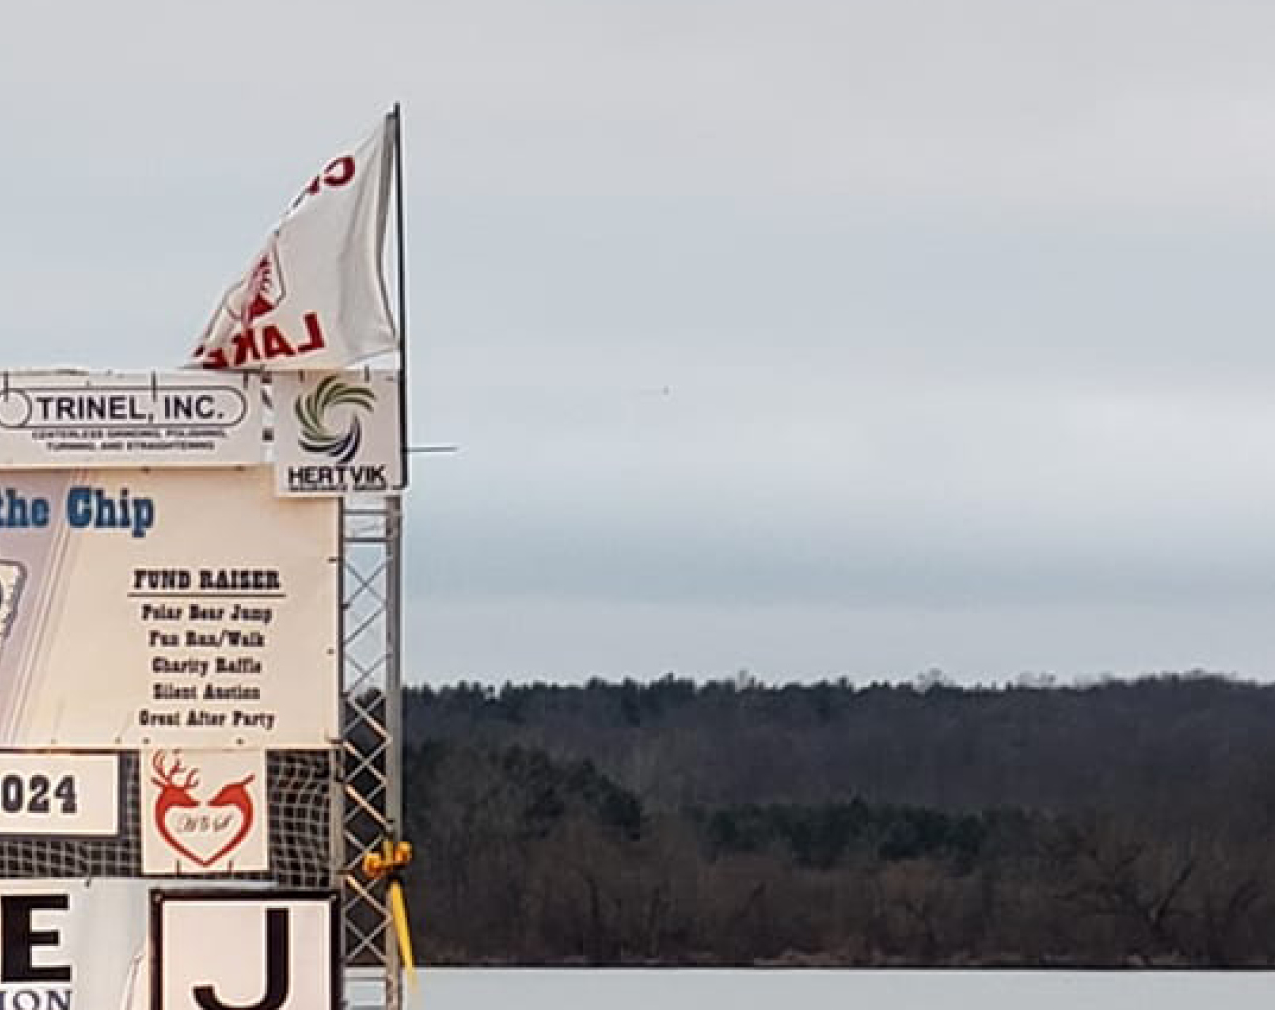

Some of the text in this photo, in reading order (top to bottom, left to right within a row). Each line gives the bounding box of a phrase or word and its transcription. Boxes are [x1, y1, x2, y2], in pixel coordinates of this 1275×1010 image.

[36, 393, 227, 425] TRINEL, INC.
[287, 464, 388, 483] HERTVIK
[65, 487, 154, 537] Chip
[133, 569, 281, 591] FUND RAISER
[141, 603, 273, 626] Polar Bear Jump
[148, 629, 180, 648] Fun
[152, 655, 263, 678] Charity Raffle
[152, 682, 261, 700] Silent Auction
[138, 708, 275, 731] Great After Party
